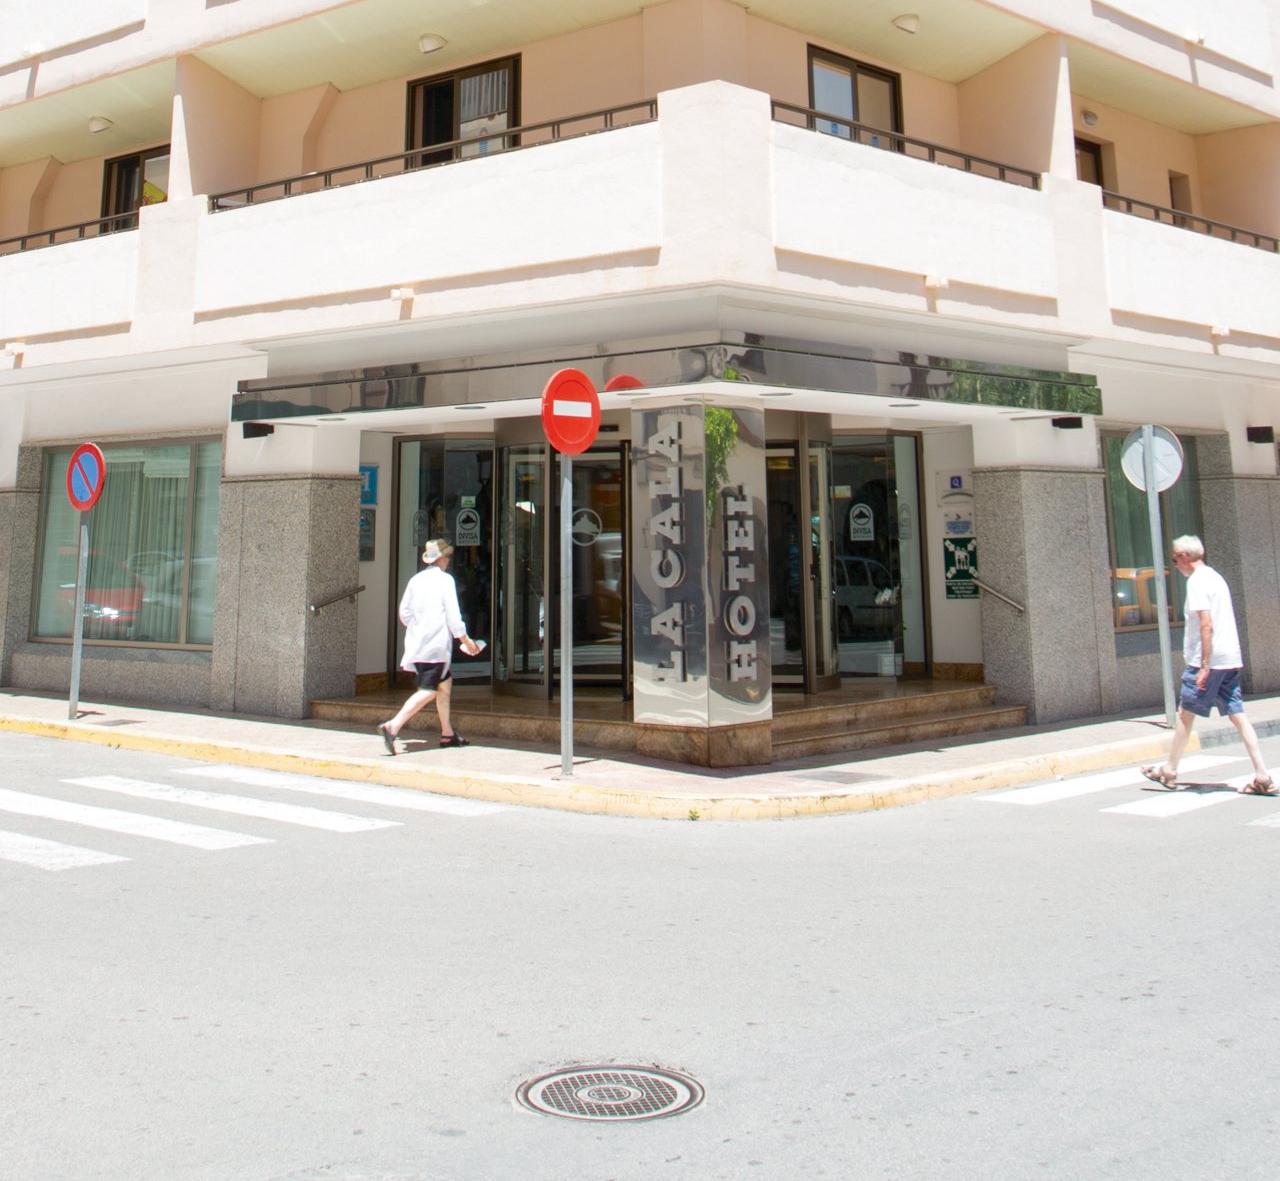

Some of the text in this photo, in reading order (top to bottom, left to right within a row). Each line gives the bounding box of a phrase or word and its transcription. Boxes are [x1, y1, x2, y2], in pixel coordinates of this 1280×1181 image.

[648, 420, 686, 683] LA CALA
[724, 483, 758, 683] HOTEL
